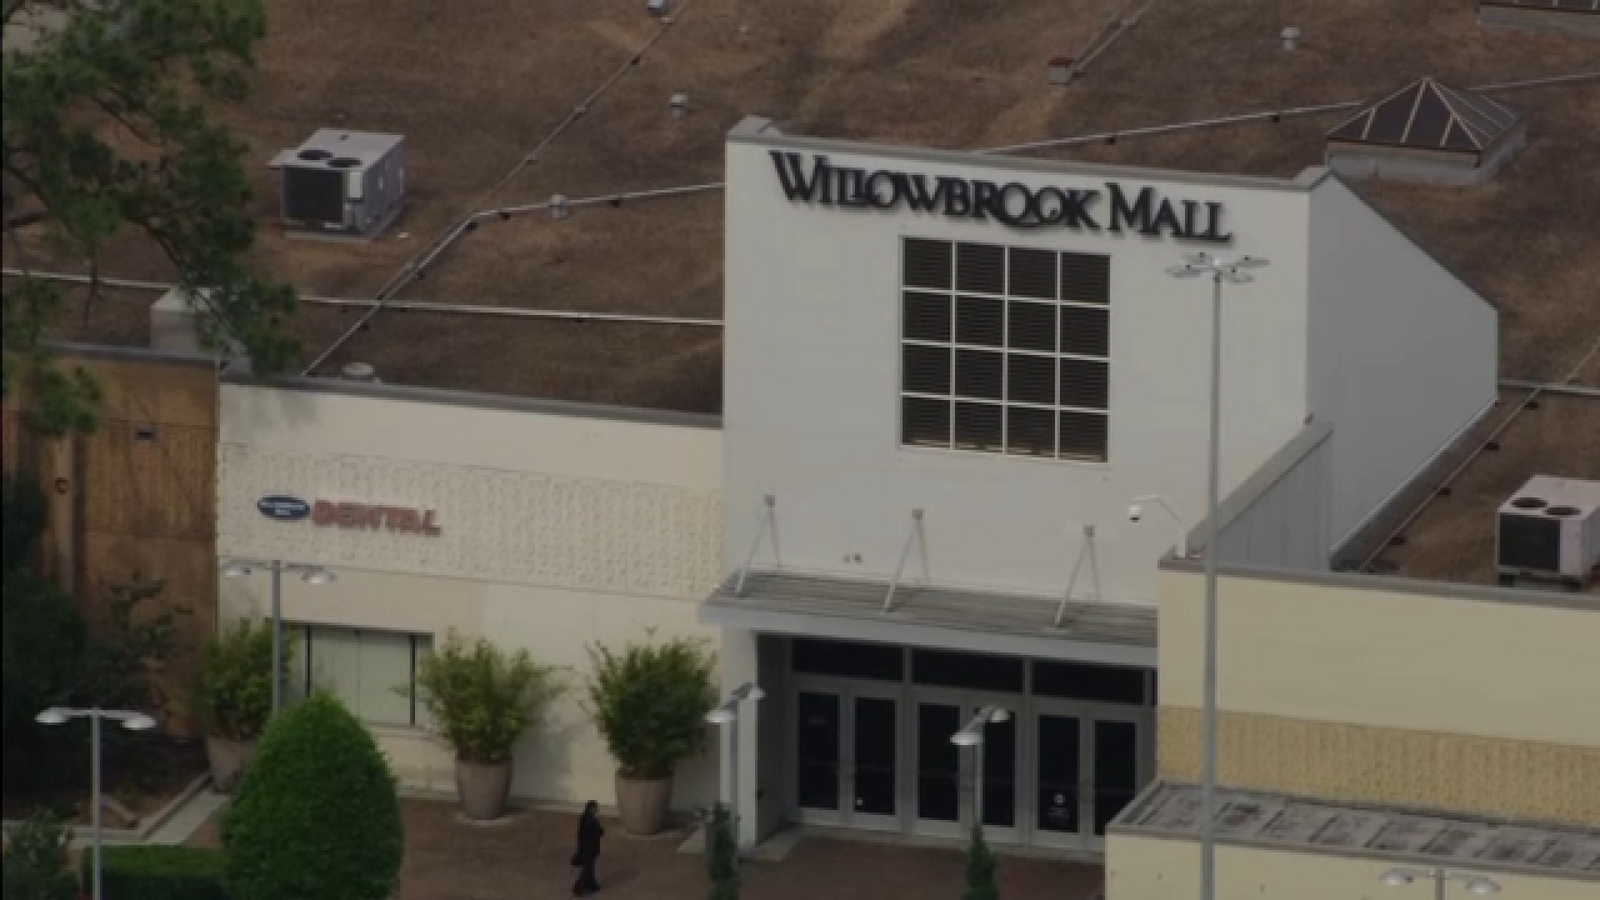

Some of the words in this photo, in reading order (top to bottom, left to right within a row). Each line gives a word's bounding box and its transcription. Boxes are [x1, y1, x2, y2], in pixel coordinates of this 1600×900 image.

[769, 150, 1101, 228] WILLOWBROOK
[1105, 181, 1233, 242] MALL
[313, 499, 441, 536] DENTAL
